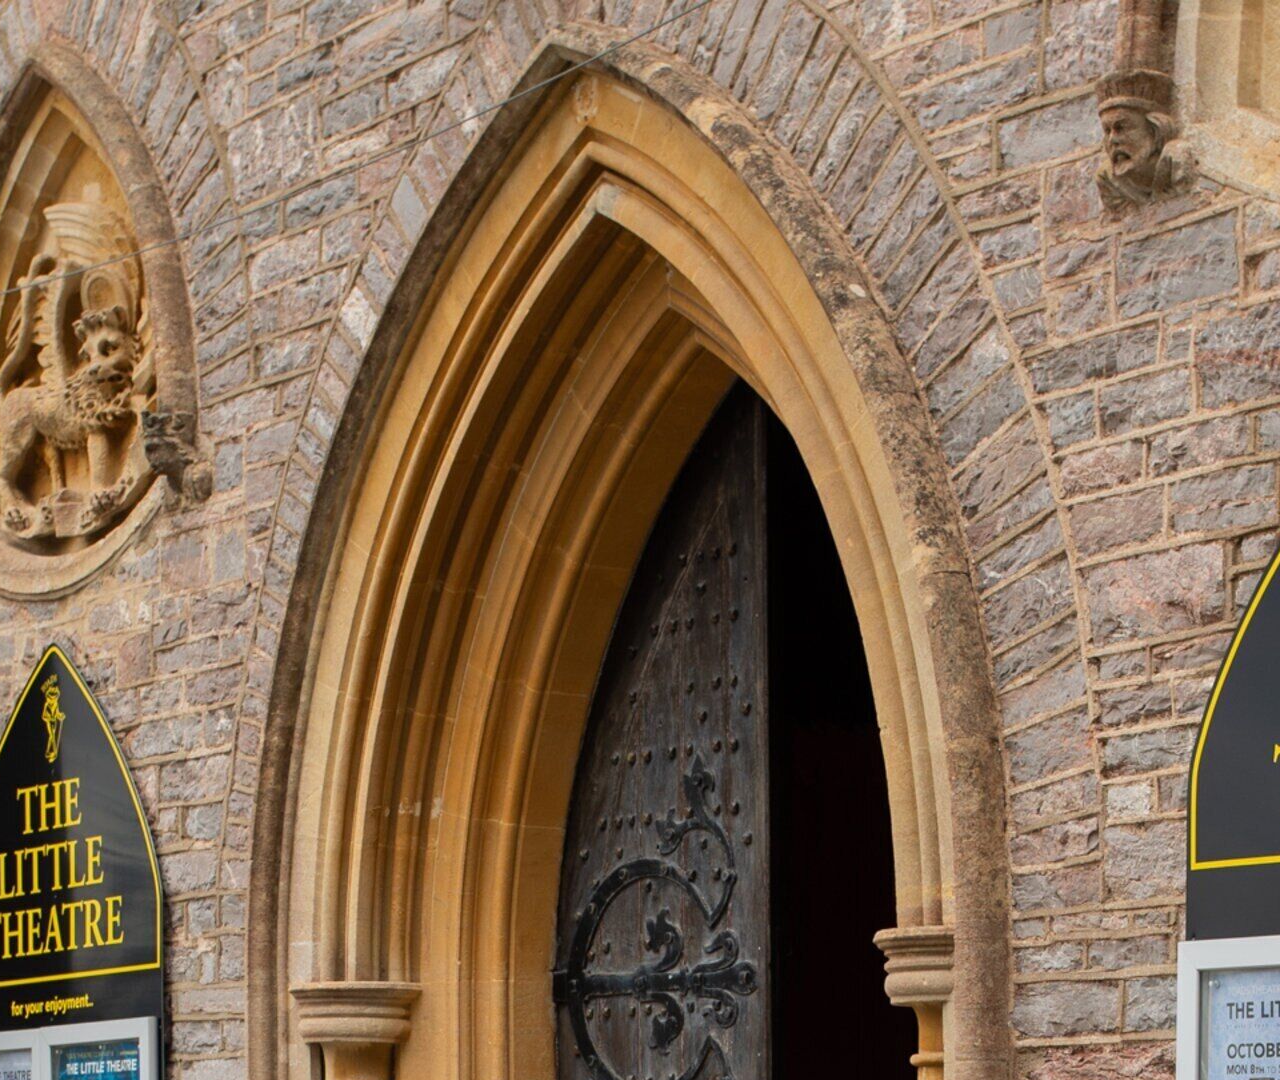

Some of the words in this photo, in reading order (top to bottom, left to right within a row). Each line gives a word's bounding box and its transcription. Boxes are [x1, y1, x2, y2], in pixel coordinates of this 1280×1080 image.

[17, 777, 82, 834] THE
[11, 1001, 23, 1016] for
[25, 1002, 44, 1019] your
[1226, 1002, 1255, 1020] THE
[66, 1063, 78, 1075] THE
[81, 1061, 105, 1074] LITTLE
[107, 1058, 137, 1073] THEATRE
[1226, 1065, 1248, 1075] MON
[1250, 1064, 1265, 1074] 8TH
[1266, 1064, 1276, 1074] TO
